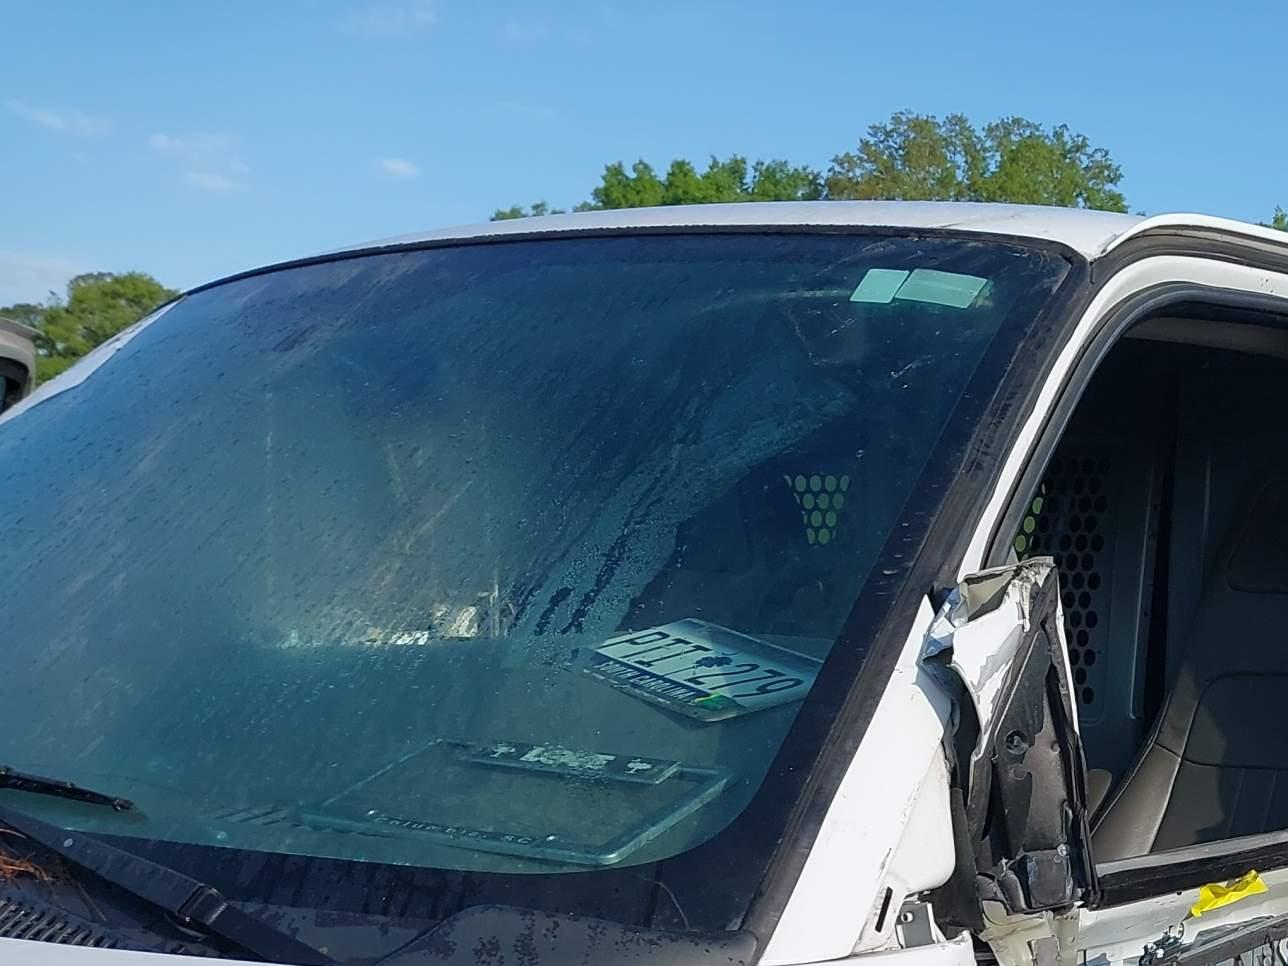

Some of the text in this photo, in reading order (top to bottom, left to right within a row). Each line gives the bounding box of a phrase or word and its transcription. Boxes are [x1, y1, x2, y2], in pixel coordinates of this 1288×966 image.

[593, 660, 697, 702] SOUTH CAROLINA
[684, 663, 804, 698] 279
